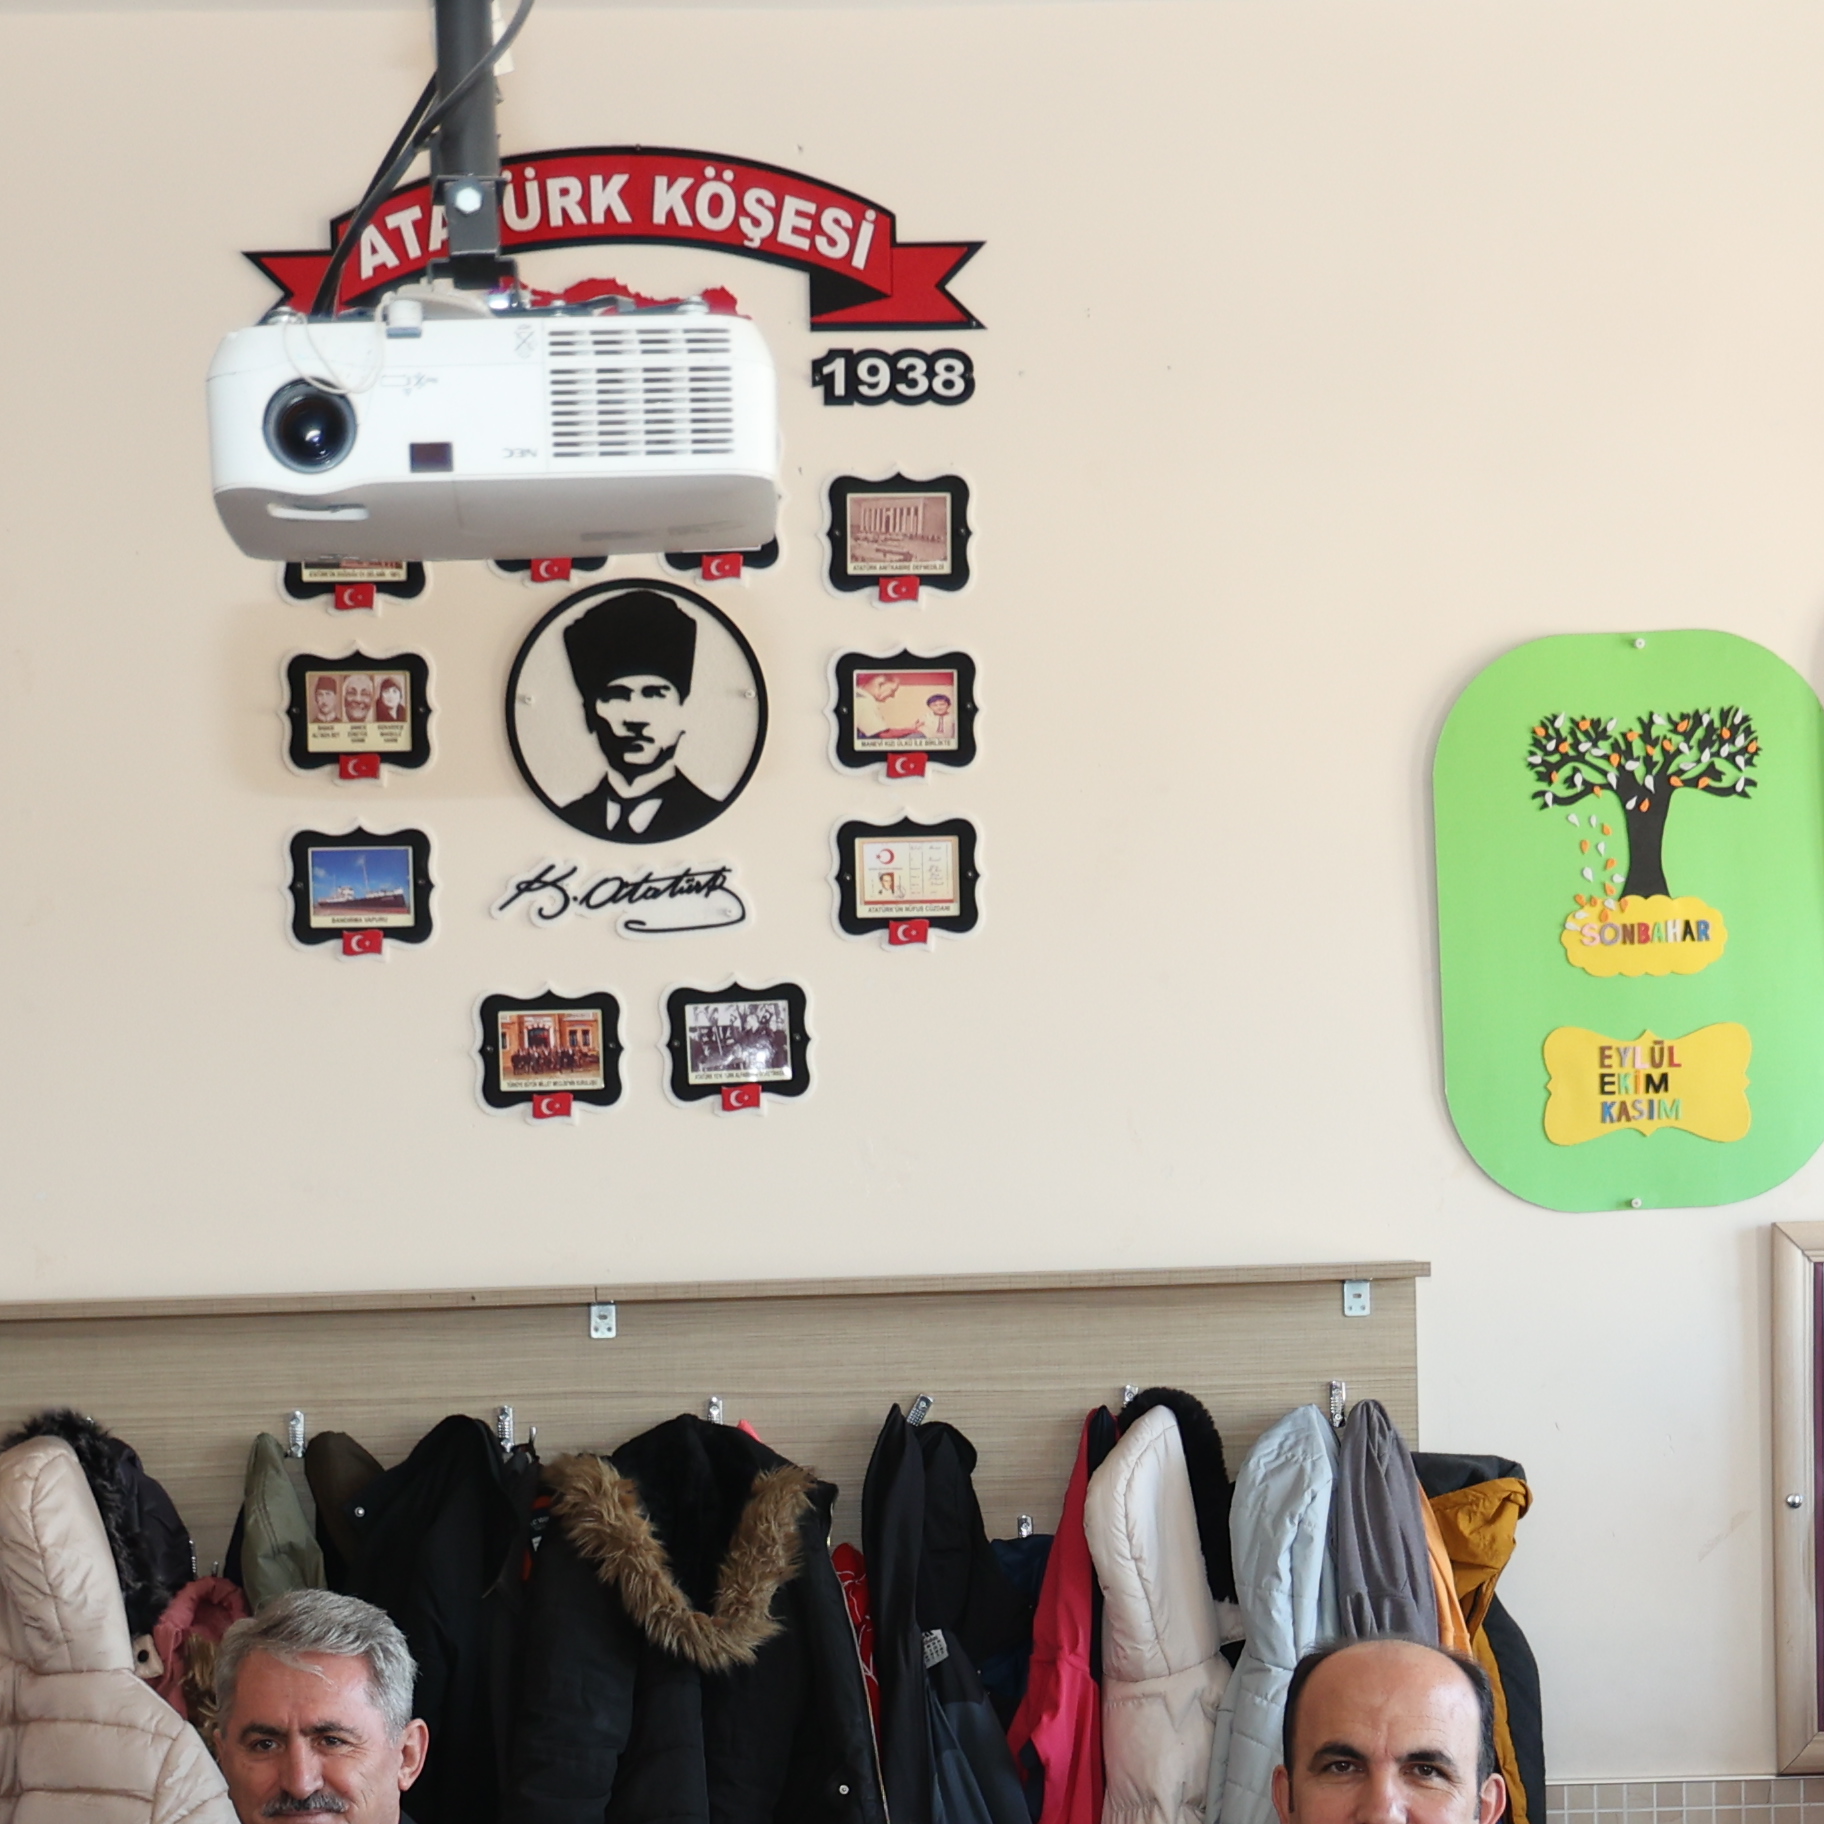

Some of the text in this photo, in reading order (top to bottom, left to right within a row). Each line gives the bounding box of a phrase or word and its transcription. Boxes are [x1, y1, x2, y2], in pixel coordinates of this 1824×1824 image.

[355, 166, 878, 278] ATAÜRK KÖŞESİ
[821, 356, 966, 398] 1938
[503, 448, 537, 458] NEC
[1580, 920, 1710, 946] SONBAHAR
[1599, 1041, 1681, 1069] EYLÜL
[1599, 1070, 1669, 1095] EKİM
[1600, 1096, 1680, 1123] KASIM
